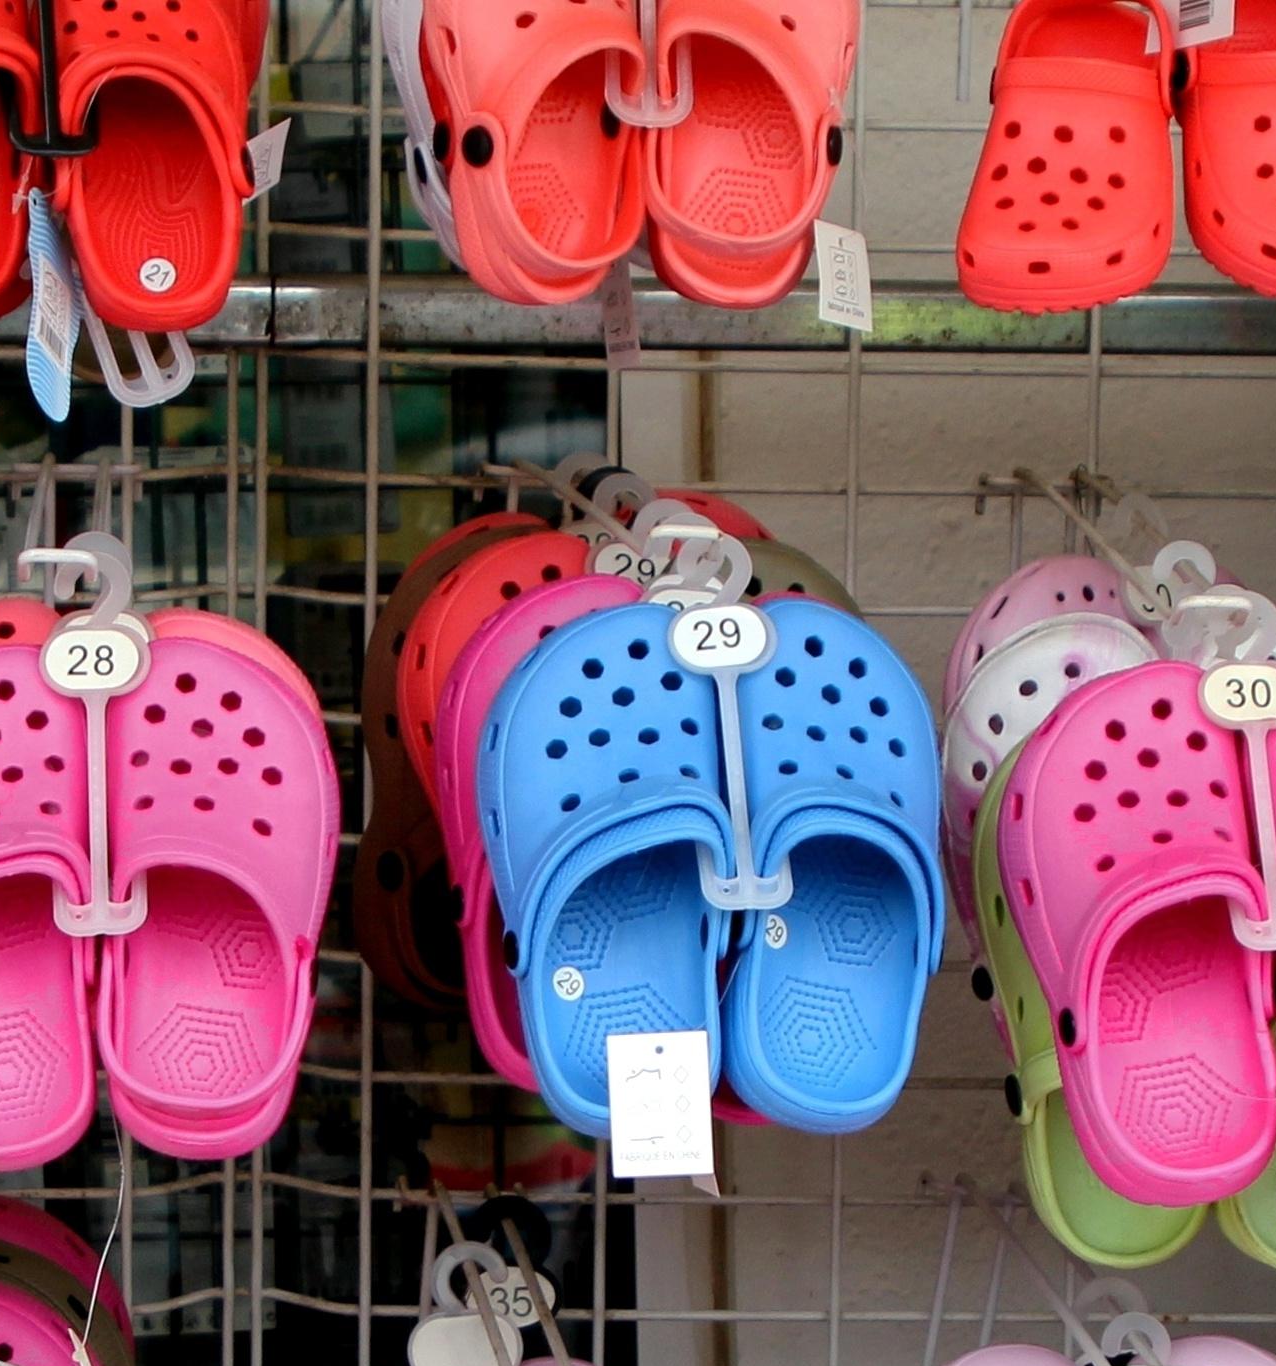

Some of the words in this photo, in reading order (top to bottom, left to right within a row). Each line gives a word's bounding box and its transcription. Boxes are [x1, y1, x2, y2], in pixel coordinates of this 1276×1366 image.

[145, 264, 170, 288] 21
[693, 617, 741, 652] 29
[66, 645, 114, 676] 28
[1225, 678, 1271, 709] 30
[765, 917, 783, 944] 29
[556, 971, 581, 997] 29
[490, 1286, 532, 1318] 35
